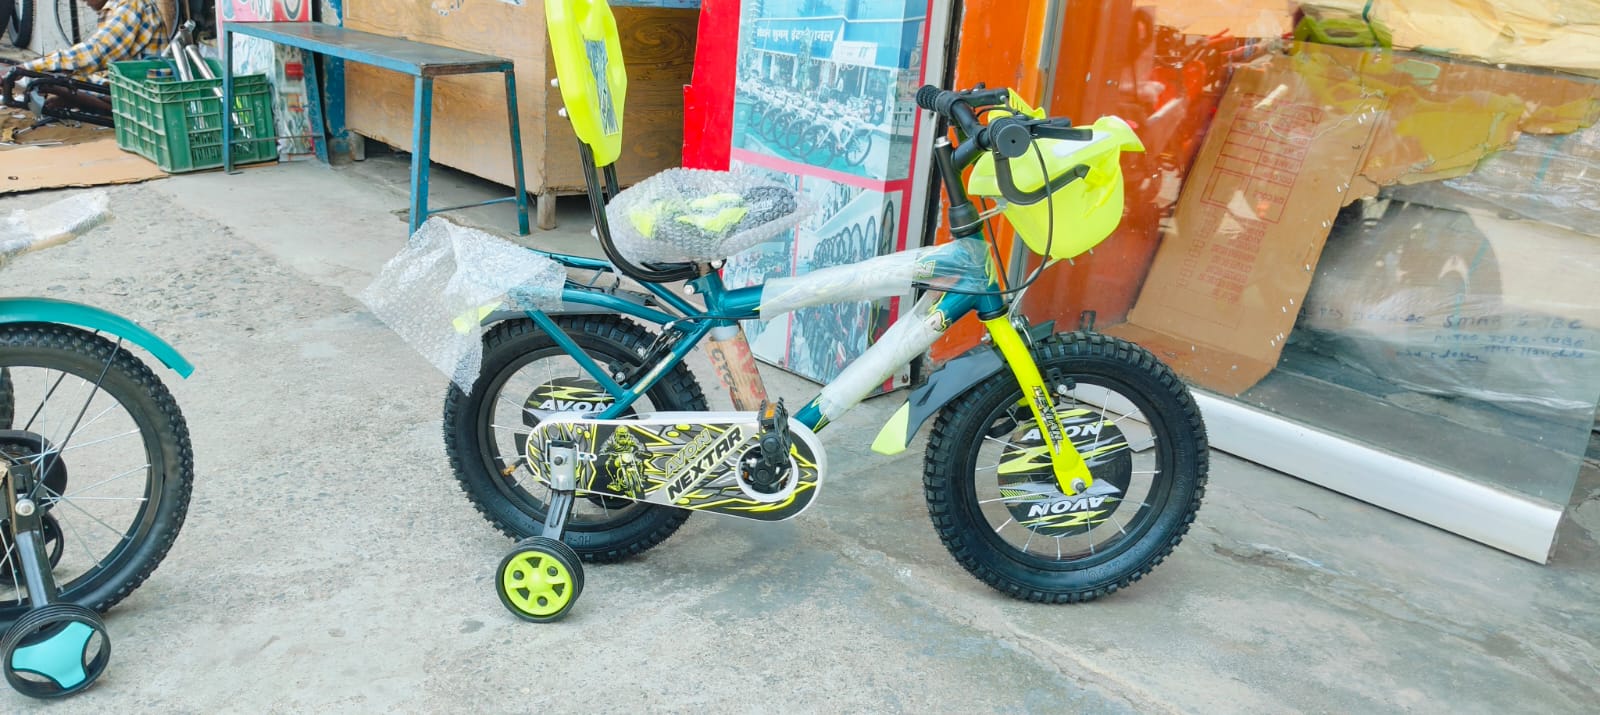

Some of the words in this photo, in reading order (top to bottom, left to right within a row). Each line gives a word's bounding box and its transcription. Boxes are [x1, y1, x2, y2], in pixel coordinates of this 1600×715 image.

[1020, 423, 1104, 441] AON
[664, 428, 713, 477] AVON
[667, 425, 743, 504] NEXTAR
[1028, 496, 1107, 517] AVON
